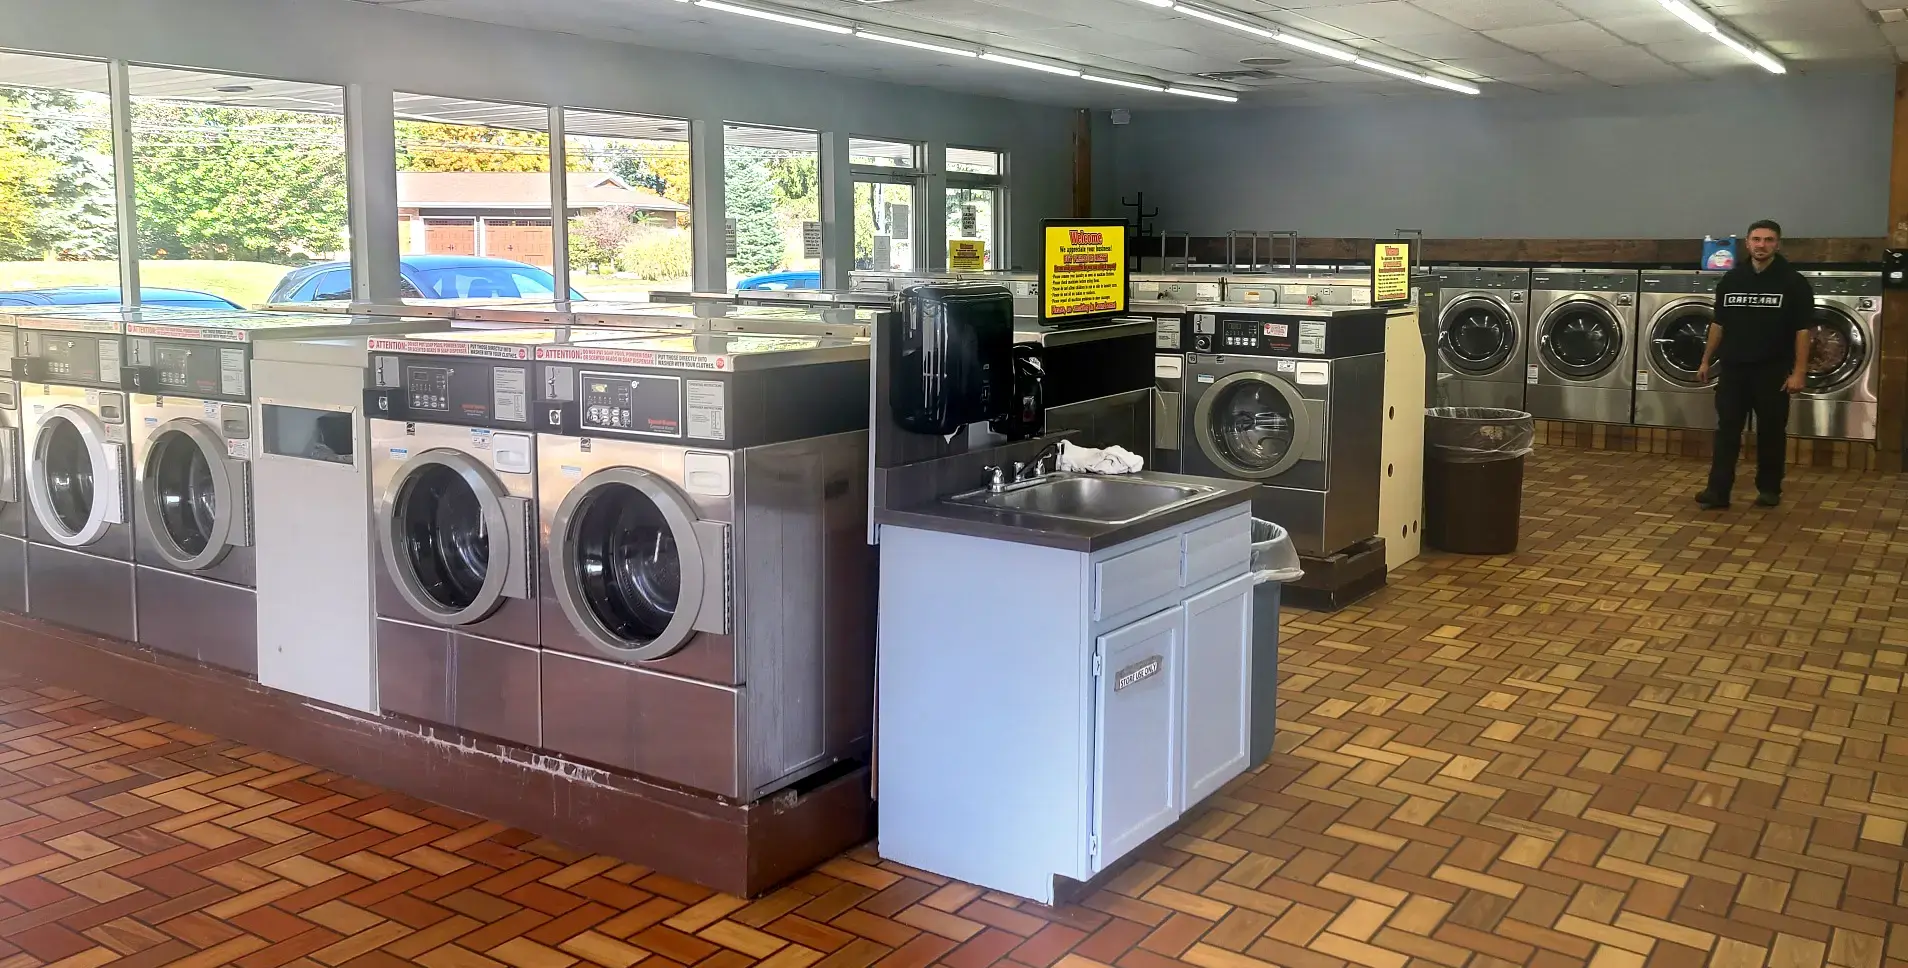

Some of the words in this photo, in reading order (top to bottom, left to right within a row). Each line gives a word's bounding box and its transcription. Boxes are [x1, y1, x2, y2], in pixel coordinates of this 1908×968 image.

[1069, 230, 1103, 245] Welcome
[1067, 246, 1085, 254] appreciate
[376, 340, 408, 350] ATTENTION:
[546, 349, 583, 360] ATTENTION:
